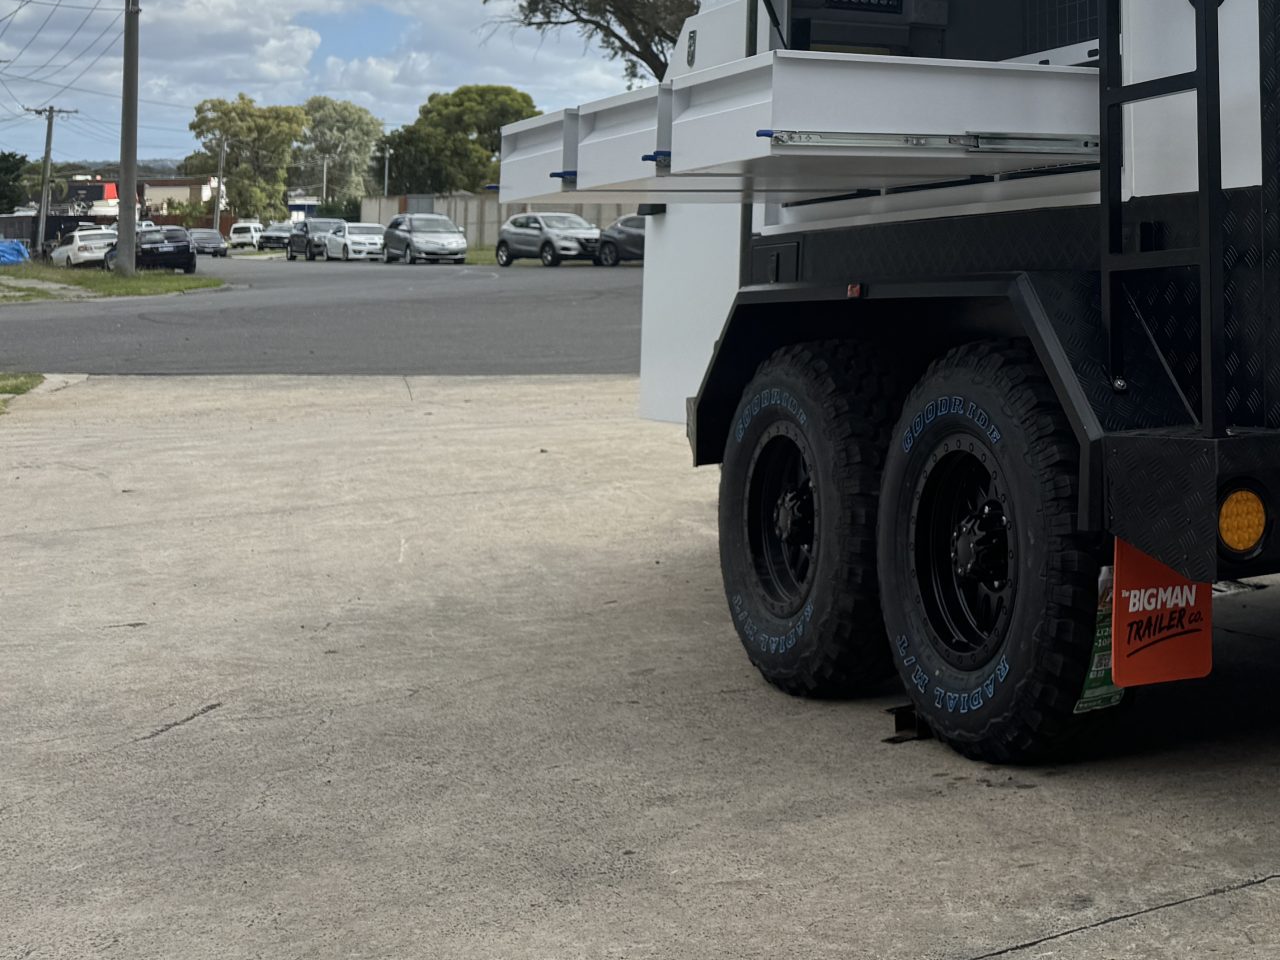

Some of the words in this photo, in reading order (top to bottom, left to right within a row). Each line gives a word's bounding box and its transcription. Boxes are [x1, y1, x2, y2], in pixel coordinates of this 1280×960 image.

[735, 388, 807, 442] GOODRIDE
[903, 396, 1001, 453] GOODRIDE
[760, 599, 815, 654] RADIAL
[1127, 608, 1185, 645] TRAILER
[934, 654, 1010, 713] RADIAL
